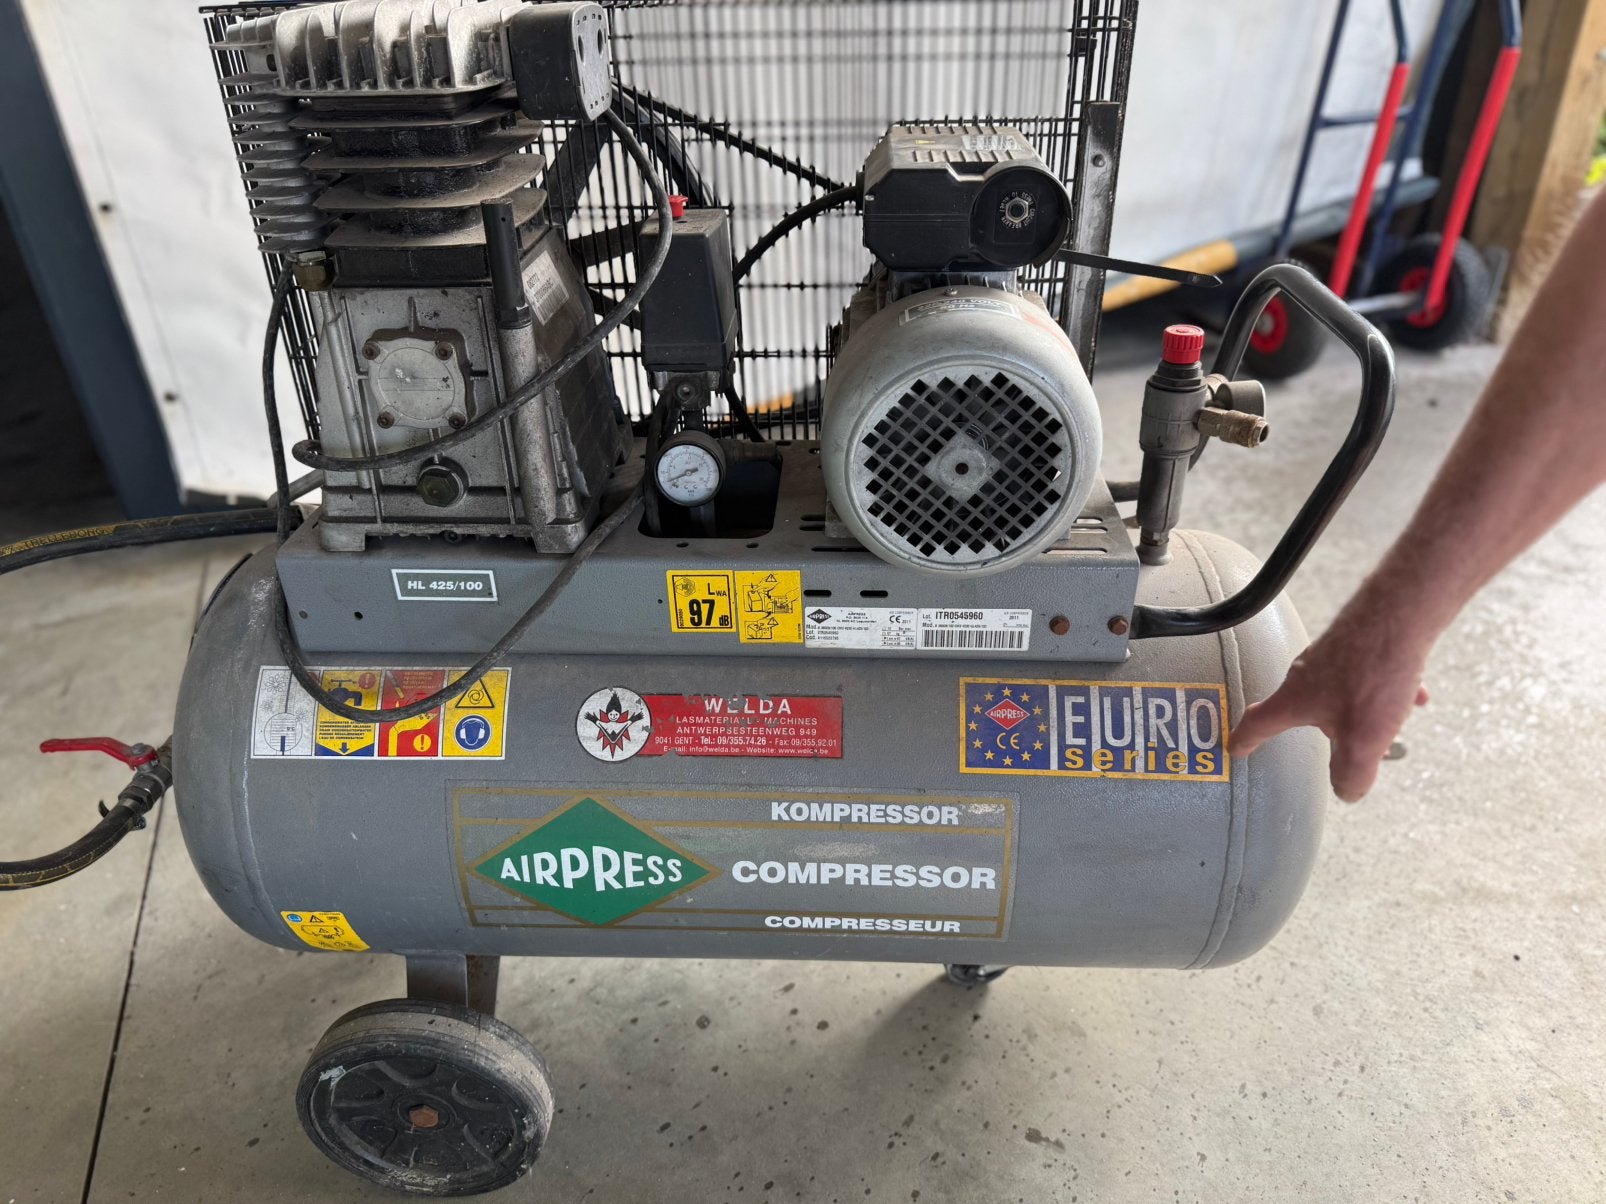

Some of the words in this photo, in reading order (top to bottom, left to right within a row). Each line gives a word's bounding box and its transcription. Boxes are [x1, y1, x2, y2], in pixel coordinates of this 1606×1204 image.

[407, 580, 426, 590] HL
[429, 581, 484, 591] 425/100
[688, 598, 716, 627] 97
[935, 611, 984, 621] ITR0545960
[718, 614, 731, 627] dB
[704, 698, 792, 715] WELDA
[676, 716, 752, 725] LASMATERIAL
[989, 709, 1025, 720] AIRPRESS
[1064, 695, 1219, 750] EURO
[676, 726, 796, 736] ANTWERPSESTEENWEG
[799, 728, 817, 737] 949
[654, 736, 672, 744] 9041
[674, 736, 694, 745] GENT
[717, 736, 767, 746] 09/355.74.26
[774, 738, 790, 746] Fax:
[689, 746, 740, 754] info@welda.be
[746, 747, 777, 755] Website:
[1064, 742, 1216, 774] series
[771, 801, 959, 826] KOMPRESSOR
[501, 845, 683, 892] AIRPRESS
[731, 860, 997, 890] COMPRESSOR
[764, 915, 961, 933] COMPRESSEUR
